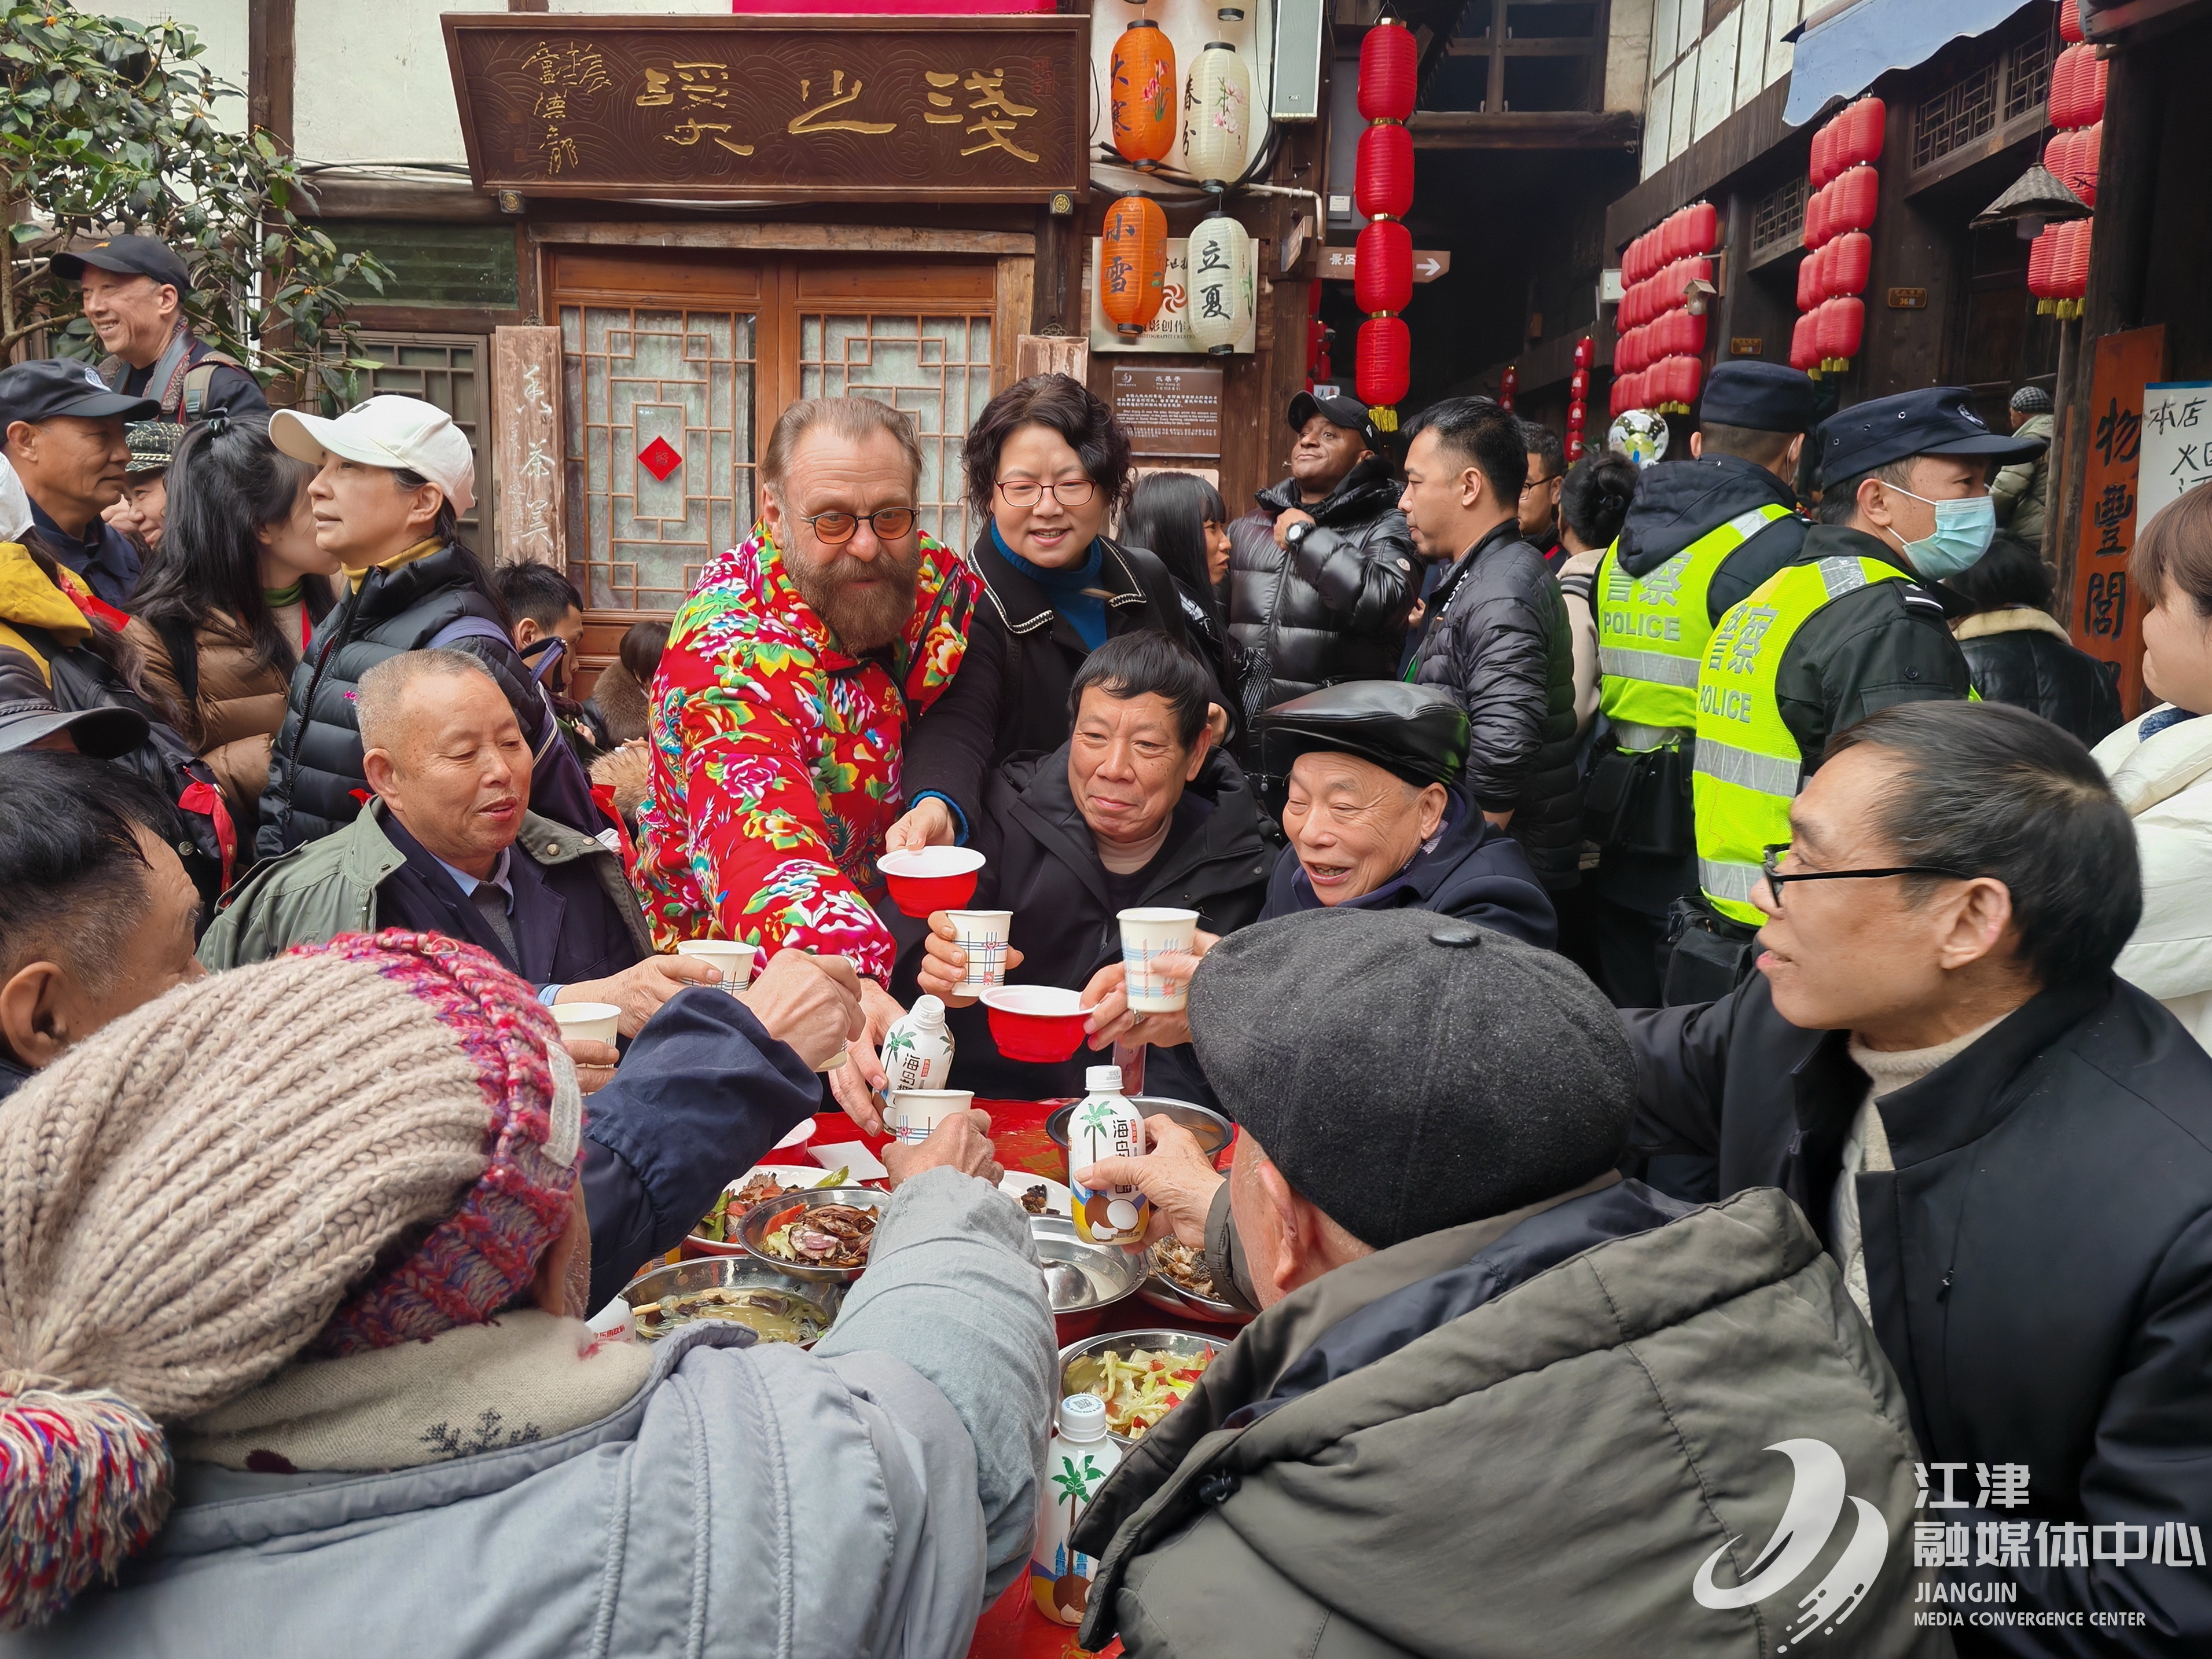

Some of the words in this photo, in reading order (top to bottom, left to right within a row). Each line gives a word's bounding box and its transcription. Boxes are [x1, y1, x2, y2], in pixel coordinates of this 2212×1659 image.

[1105, 212, 1135, 294] 小雪
[1197, 240, 1231, 320] 立夏
[2148, 397, 2207, 435] 本店
[1606, 552, 1693, 607] 警察
[1603, 611, 1682, 641] POLICE
[1707, 602, 1779, 676] 警察
[1699, 685, 1752, 724] POLICE
